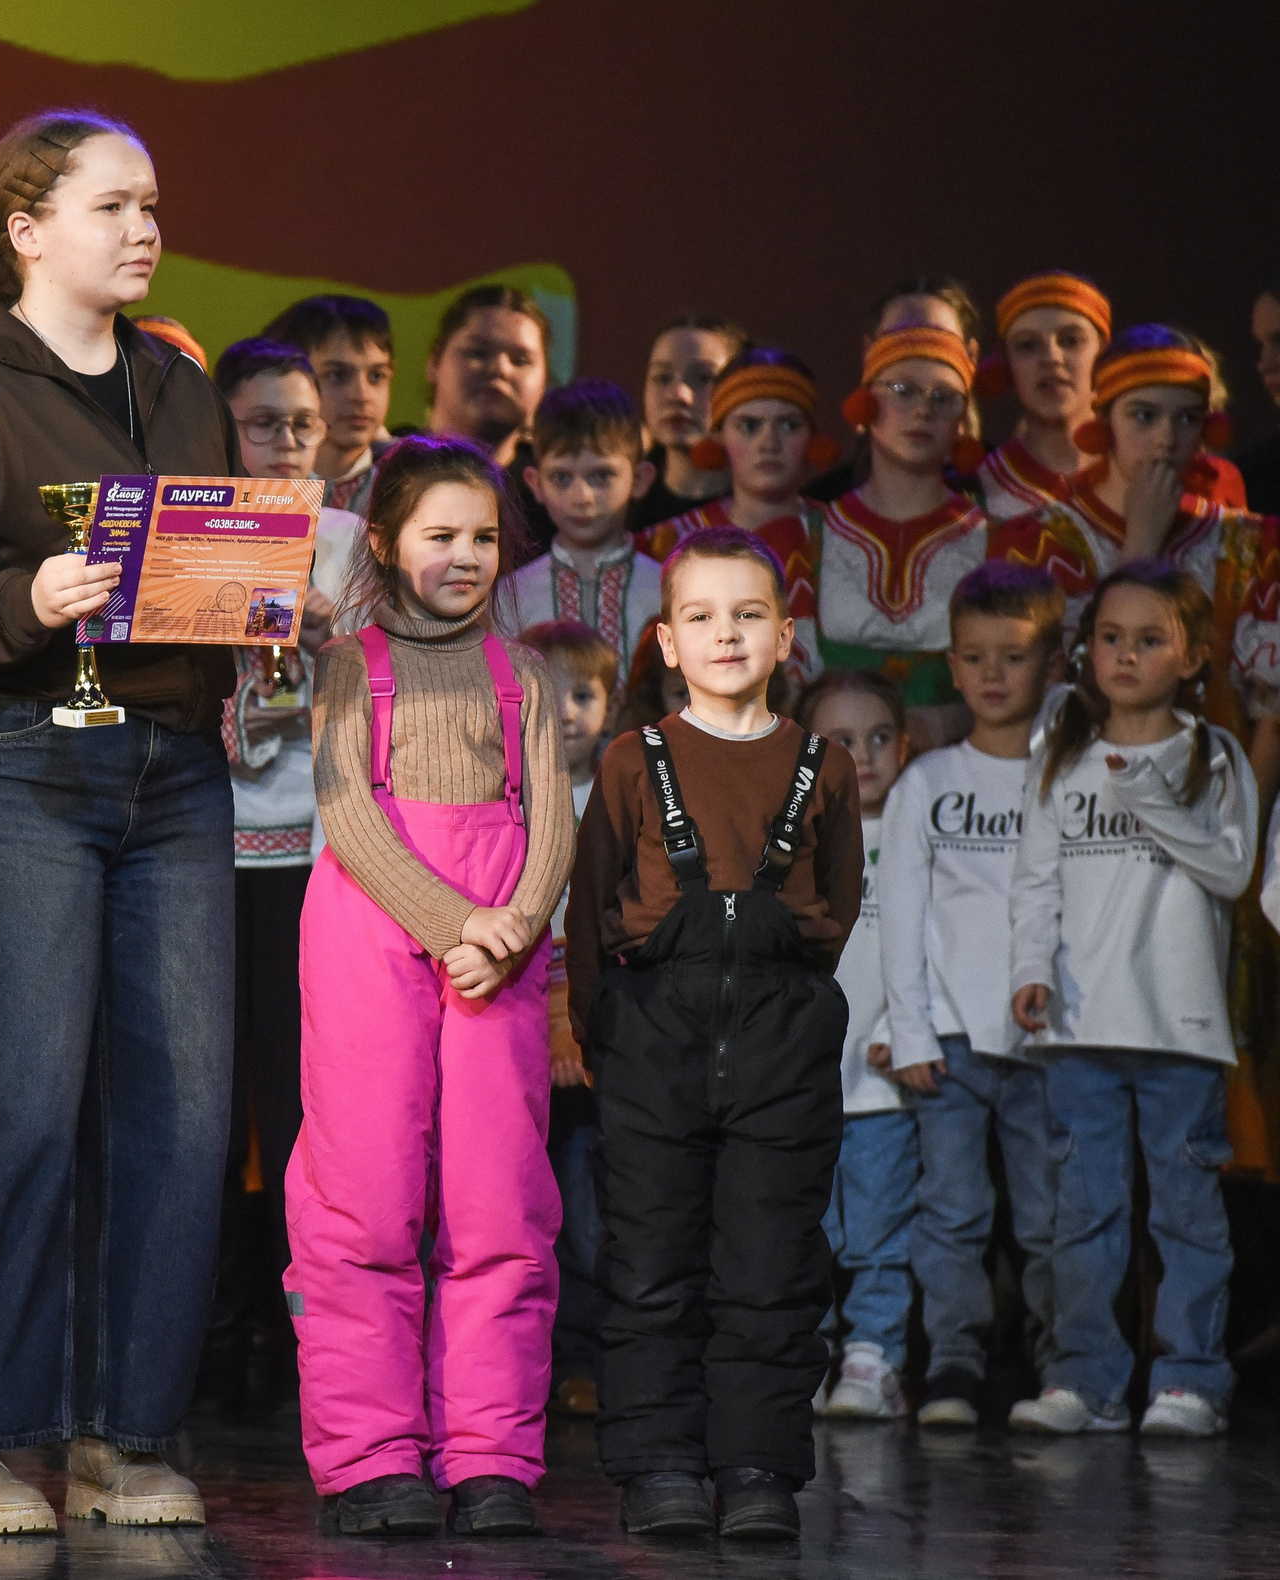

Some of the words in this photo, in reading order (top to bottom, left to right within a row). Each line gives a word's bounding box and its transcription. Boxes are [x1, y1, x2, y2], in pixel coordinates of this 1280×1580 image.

[170, 489, 226, 503] ЛАУРЕАТ
[256, 495, 294, 505] СТЕПЕНИ
[205, 518, 260, 530] «СОЗВЕЗДИЕ»
[657, 760, 677, 811] Michelle
